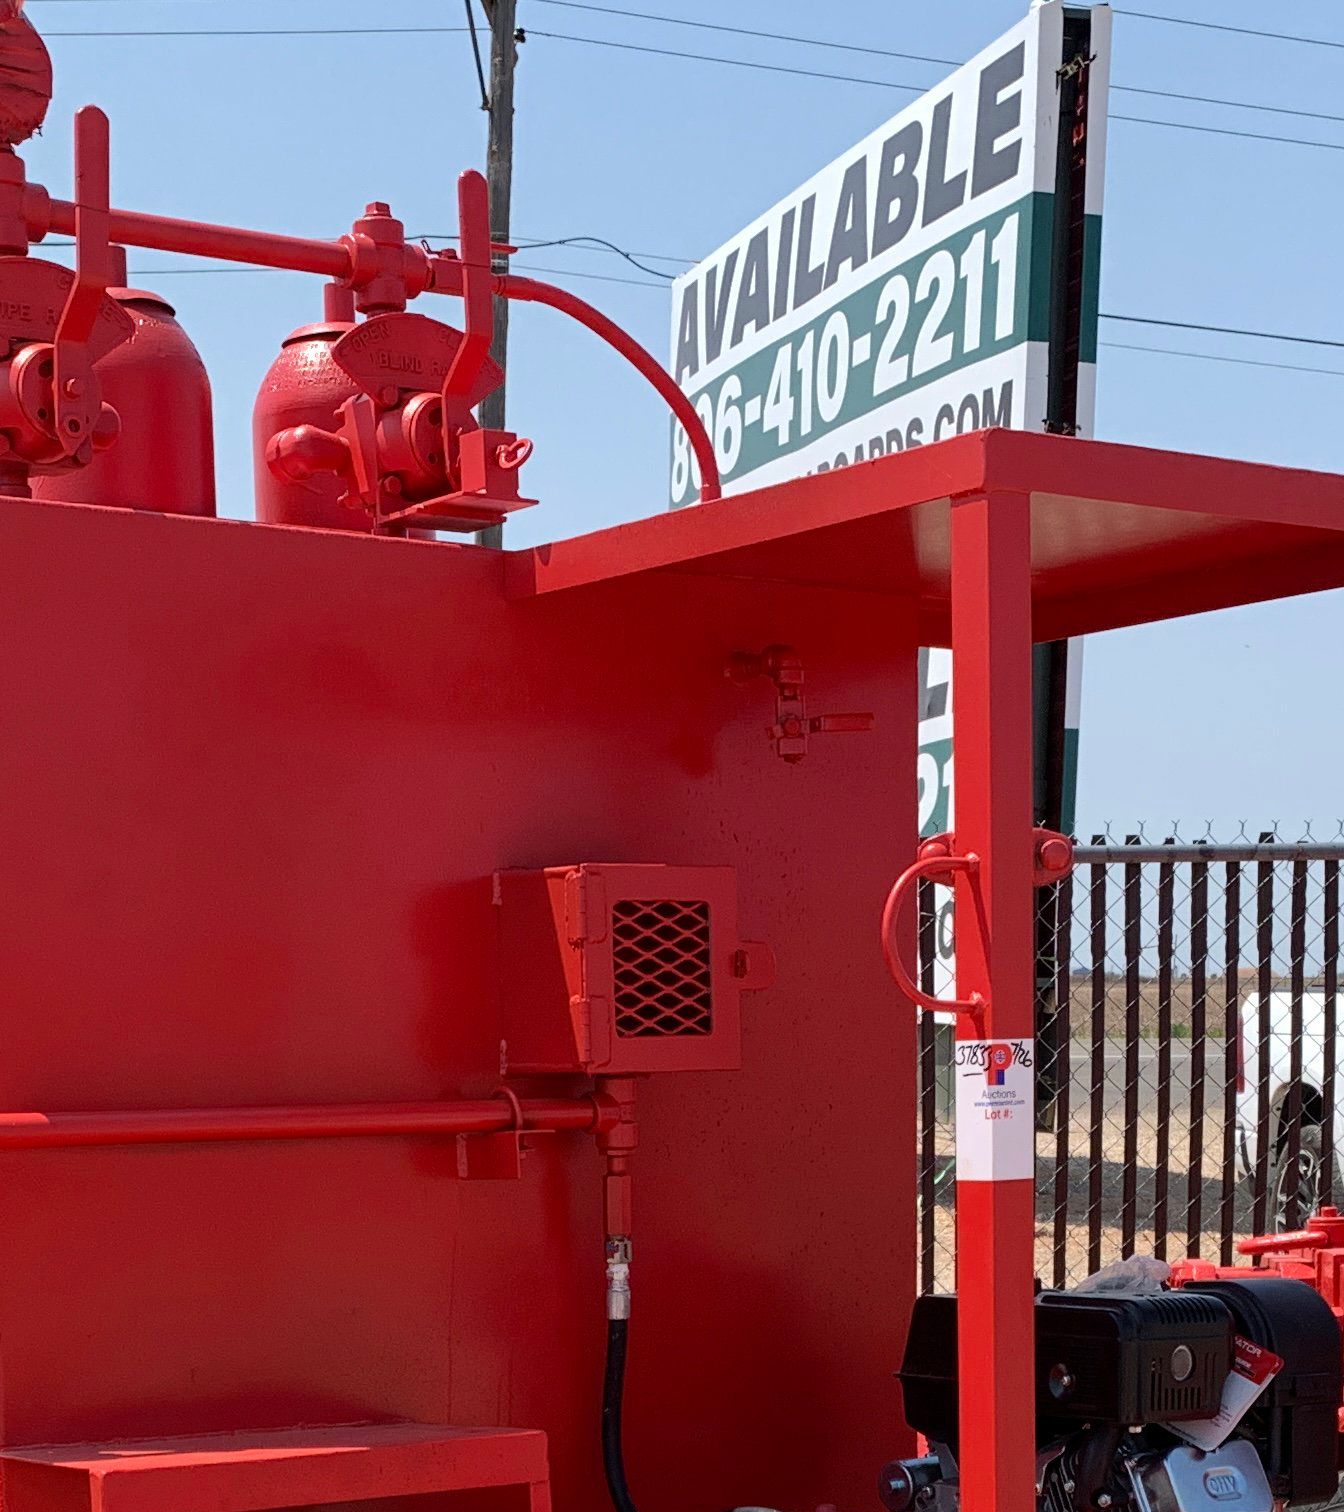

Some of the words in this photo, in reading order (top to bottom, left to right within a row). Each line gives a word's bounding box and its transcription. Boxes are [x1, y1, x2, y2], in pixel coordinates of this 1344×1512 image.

[674, 39, 1026, 387] AVAILABLE
[982, 1089, 1017, 1099] Auctions
[984, 1109, 1001, 1120] Lot
